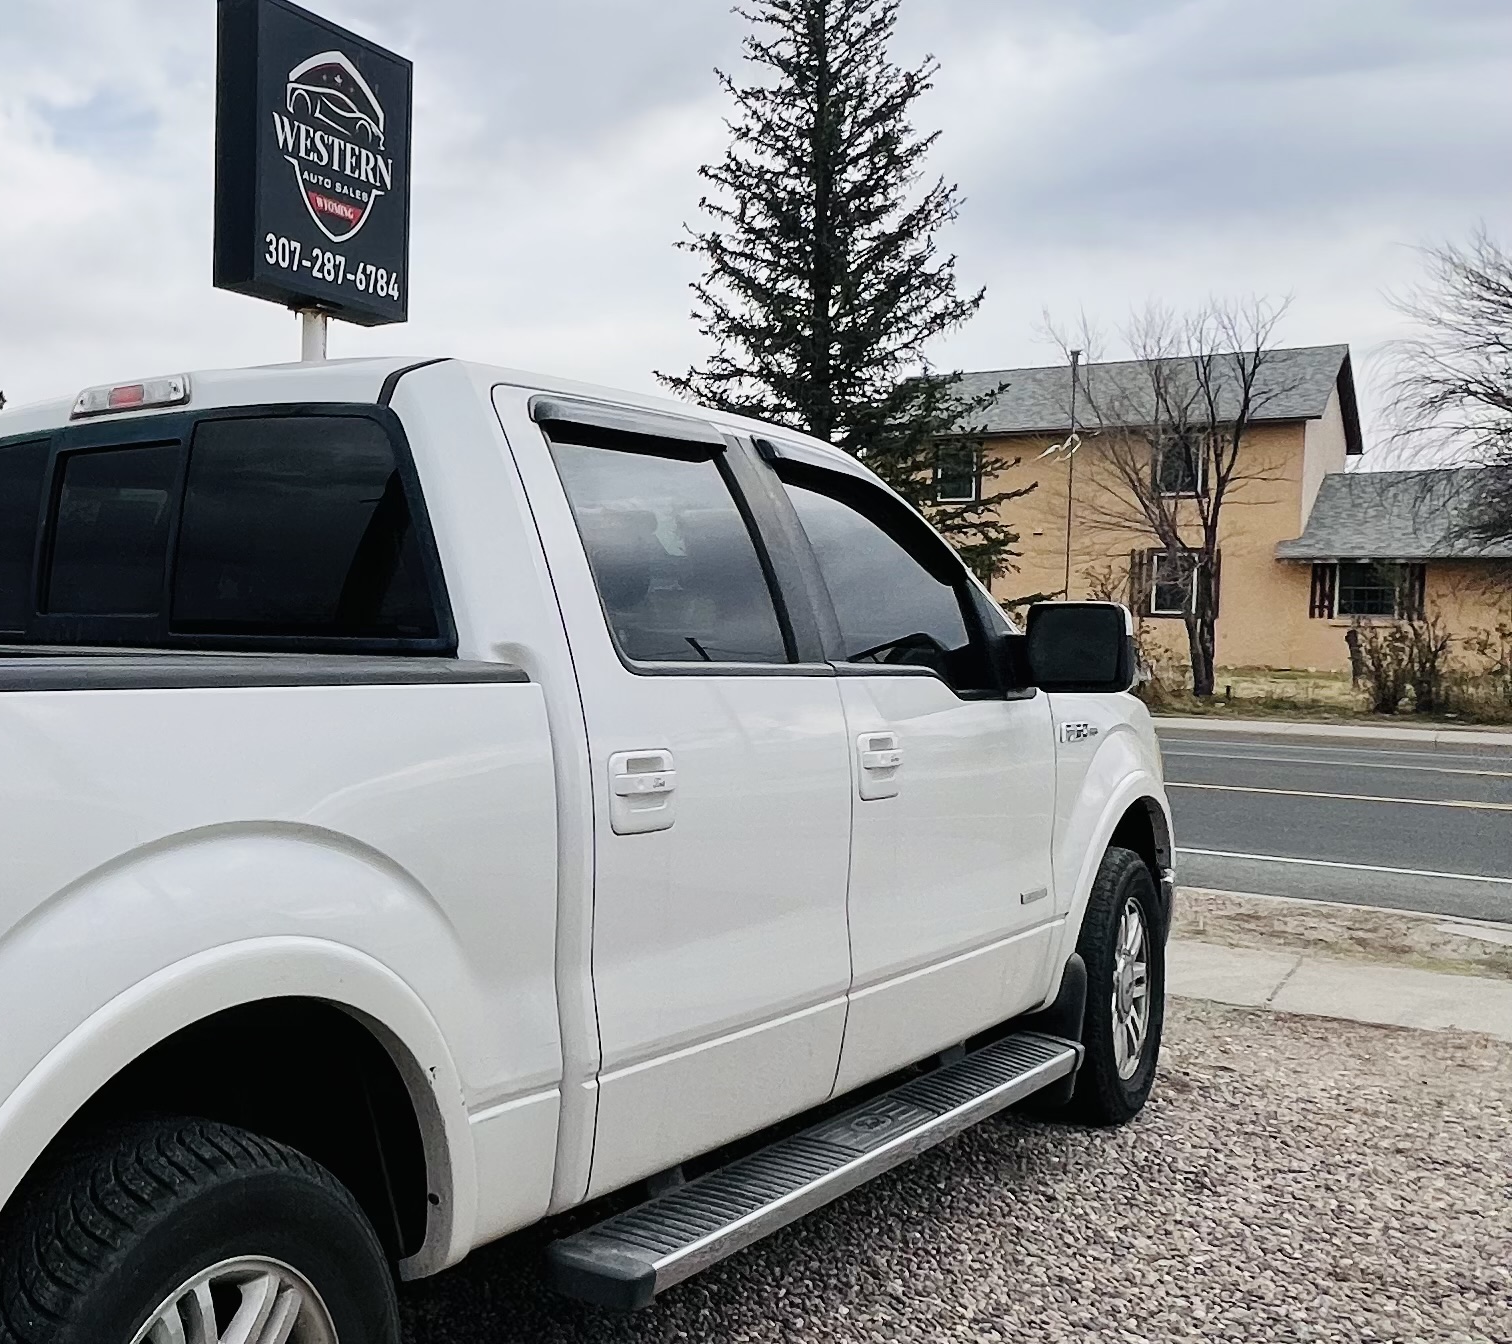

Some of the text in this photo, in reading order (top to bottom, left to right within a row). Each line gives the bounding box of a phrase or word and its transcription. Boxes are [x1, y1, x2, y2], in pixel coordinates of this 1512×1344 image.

[272, 111, 393, 191] WESTERN
[302, 170, 369, 203] AUTO SALES
[315, 196, 355, 219] WYOMING
[265, 233, 399, 300] 307-287-6784
